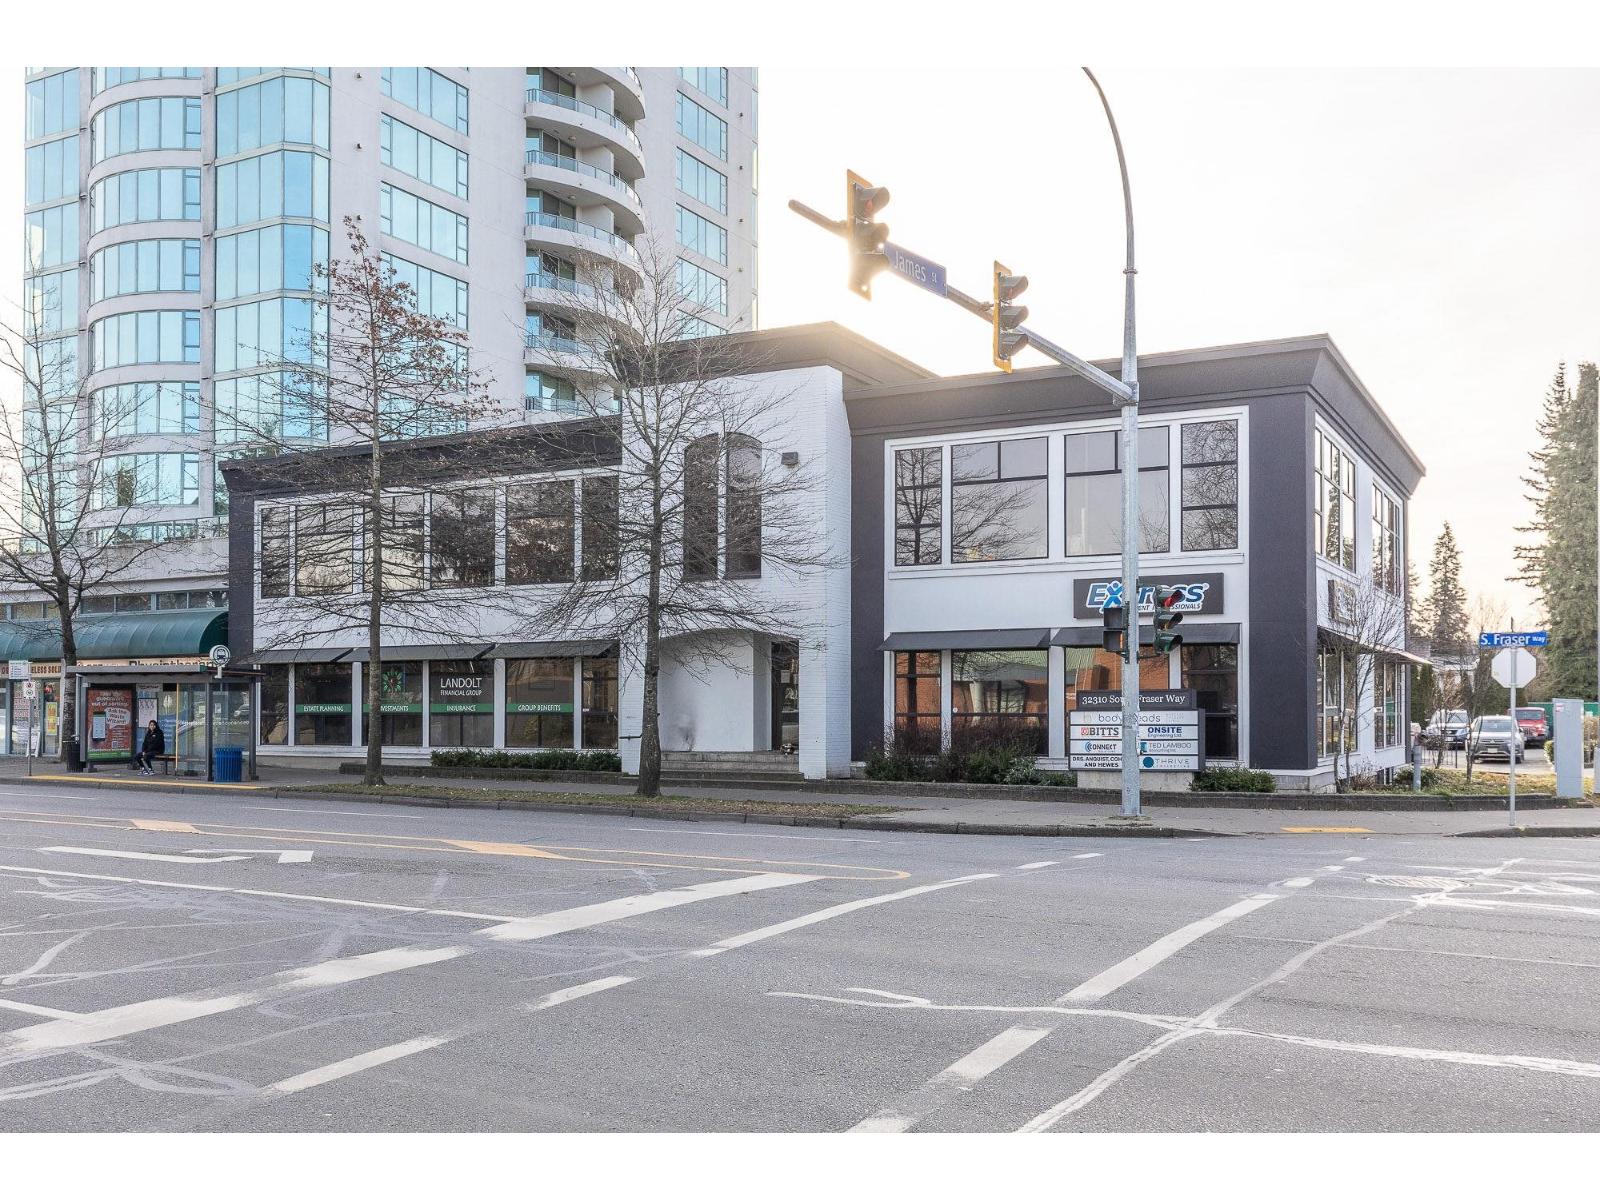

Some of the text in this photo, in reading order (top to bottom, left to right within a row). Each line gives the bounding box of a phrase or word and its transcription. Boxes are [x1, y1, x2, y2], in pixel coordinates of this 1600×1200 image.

[894, 250, 926, 282] James
[1480, 633, 1490, 645] S.
[1494, 633, 1530, 645] Fraser
[440, 677, 482, 688] LANDOLT
[1082, 696, 1107, 704] 32310
[1165, 694, 1186, 704] Way
[518, 704, 536, 712] GROUP
[1090, 727, 1119, 736] BITTS
